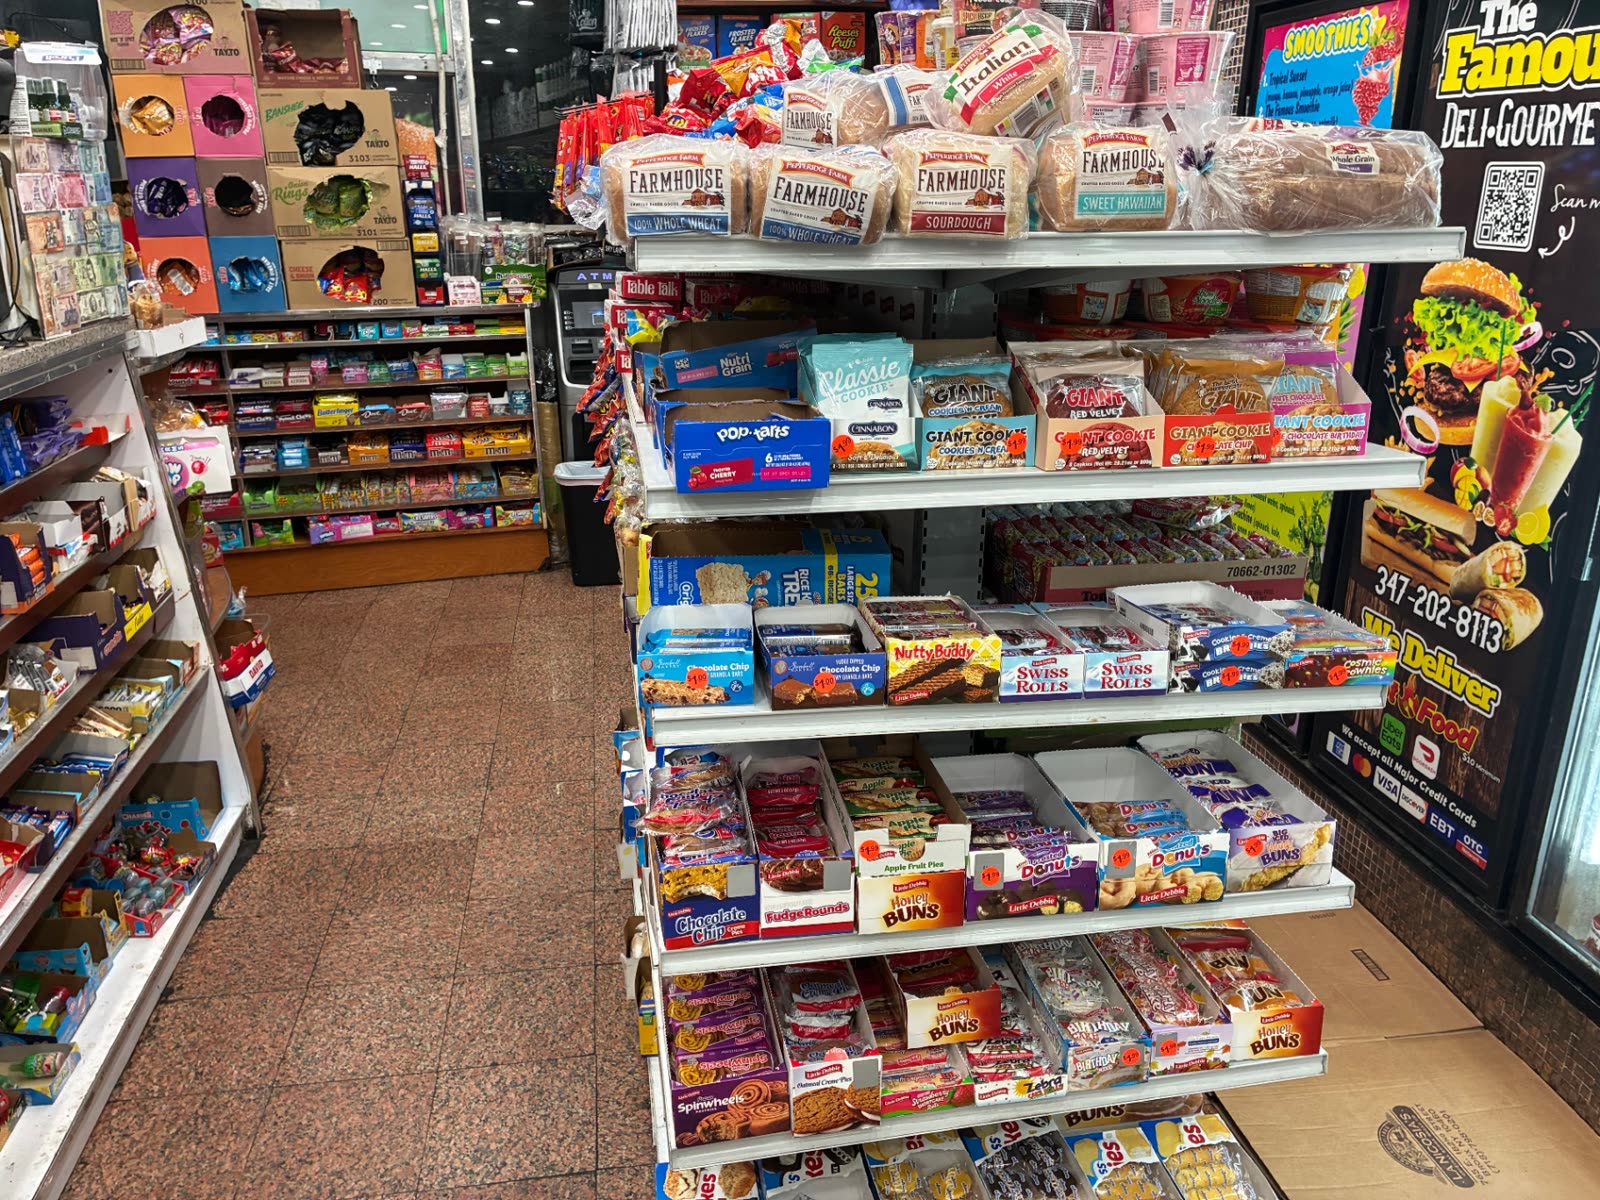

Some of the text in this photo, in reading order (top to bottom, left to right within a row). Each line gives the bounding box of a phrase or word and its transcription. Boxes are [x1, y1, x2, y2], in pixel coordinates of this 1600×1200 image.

[1480, 0, 1537, 36] The
[685, 24, 710, 33] FROSTED
[728, 29, 756, 38] FROSTED
[730, 34, 754, 42] FLAKES
[831, 37, 857, 49] Puffs
[1284, 15, 1371, 60] SMOOTHIES
[213, 48, 239, 56] TAYTO
[957, 40, 1031, 96] Italian
[992, 70, 1018, 90] White
[1270, 68, 1307, 87] Tropical Sunset
[1266, 99, 1320, 117] The Famous Smoothie
[786, 109, 832, 130] FARMHOUSE
[349, 155, 370, 163] 3103
[1331, 154, 1375, 163] Whole Grain
[786, 161, 827, 174] PEPPERIDGE
[629, 168, 723, 193] FARMHOUSE
[917, 169, 1006, 192] FARMHOUSE
[272, 186, 309, 205] Rings
[774, 176, 868, 213] FARMHOUSE
[1082, 195, 1162, 210] SWEET HAWAIIAN
[1551, 183, 1587, 212] Scan
[653, 216, 721, 230] WHOLE WHEAT
[926, 216, 992, 230] SOURDOUGH
[356, 228, 377, 236] 3101
[788, 227, 820, 242] WHOLE
[577, 272, 612, 280] ATM
[626, 279, 678, 296] Table Talk
[373, 298, 388, 306] 200
[720, 352, 750, 368] Nutri
[722, 362, 752, 378] Grain
[819, 356, 900, 400] Classic
[933, 384, 996, 405] GIANT
[1066, 387, 1125, 407] GIANT
[1200, 389, 1262, 410] GIANT
[316, 407, 354, 417] Butterfinger
[869, 400, 902, 408] CINNABON
[928, 403, 1002, 416] COOKIES CREAM
[361, 410, 381, 418] Dove
[399, 408, 417, 417] Dove
[1070, 407, 1124, 419] RED VELVET
[1313, 413, 1366, 428] COOKIE
[851, 424, 895, 433] CINNABON
[926, 431, 972, 442] GIANT
[1104, 428, 1155, 442] COOKIE
[1170, 423, 1270, 440] GIANT COOKIE
[1288, 430, 1364, 440] CHOCOLATE BIRTHDAY
[938, 446, 975, 455] COOKIES
[1081, 446, 1129, 457] RED VELVET
[1235, 439, 1253, 449] CHIP
[765, 453, 773, 463] 6
[848, 453, 862, 463] Soft
[710, 470, 736, 480] CHERRY
[846, 565, 854, 590] LARGE
[1226, 563, 1297, 578] 70662-01302
[798, 568, 810, 591] RICE
[836, 573, 846, 600] BARS
[855, 572, 879, 600] 25
[1375, 566, 1505, 654] 347-202-8113
[1365, 612, 1402, 654] We
[895, 643, 975, 662] Nutty Buddy
[249, 660, 264, 679] DAVID
[730, 663, 749, 672] Chip
[819, 664, 881, 673] Chocolate Chip
[1101, 663, 1152, 677] SWISS
[1344, 658, 1381, 668] Cosmic
[1017, 666, 1069, 680] SWISS
[1403, 632, 1499, 712] Deliver
[687, 673, 708, 688] $1.00
[814, 678, 834, 693] $1.00
[1016, 680, 1068, 693] ROLLS
[1101, 676, 1151, 690] ROLLS
[1383, 718, 1404, 739] Uber
[1416, 698, 1478, 752] Food
[1381, 730, 1401, 751] Eats
[1462, 751, 1475, 767] $10
[1342, 723, 1353, 738] We
[1353, 735, 1381, 761] accept
[1381, 755, 1395, 768] all
[1394, 762, 1419, 786] Major
[1419, 779, 1448, 808] Credit
[1448, 802, 1478, 829] Cards
[861, 779, 886, 791] Apple
[1376, 771, 1399, 798] VISA
[1401, 792, 1426, 815] DISCOVER
[889, 815, 927, 828] Apple
[1429, 812, 1456, 839] EBT
[1463, 834, 1484, 855] OTC
[1152, 844, 1211, 868] Donuts
[1261, 849, 1300, 865] BUNS
[884, 864, 906, 873] Apple
[908, 862, 926, 870] Fruit
[1021, 855, 1082, 880] Donuts
[894, 880, 927, 892] Little Debbie
[891, 893, 929, 909] Honey
[1140, 888, 1186, 903] Little Debbie
[765, 902, 849, 923] Fudge Rounds
[1008, 898, 1055, 913] Little Debbie
[675, 907, 746, 934] Chocolate
[883, 903, 940, 928] BUNS
[693, 924, 725, 945] Chip
[727, 923, 746, 932] Creme
[1209, 954, 1249, 971] BUN
[937, 1009, 970, 1025] Honey
[928, 1017, 979, 1042] BUNS
[1067, 1020, 1130, 1036] BIRTHDAY
[1258, 1024, 1291, 1039] Honey
[1250, 1033, 1301, 1055] BUNS
[1076, 1053, 1118, 1073] BIRTHDAY
[807, 1065, 842, 1079] Little Debbie
[797, 1076, 852, 1089] Oatmeal Creme Pies
[1023, 1076, 1063, 1094] Zebra
[678, 1095, 745, 1114] Spinwheels
[911, 1089, 951, 1107] Strawberry
[1066, 1105, 1126, 1127] BUNS
[1414, 1103, 1441, 1132] STREET
[1399, 1112, 1464, 1181] LA NICOSIA'S
[1451, 1135, 1465, 1148] NY
[1463, 1148, 1491, 1177] BRONX
[1471, 1168, 1489, 1186] 765
